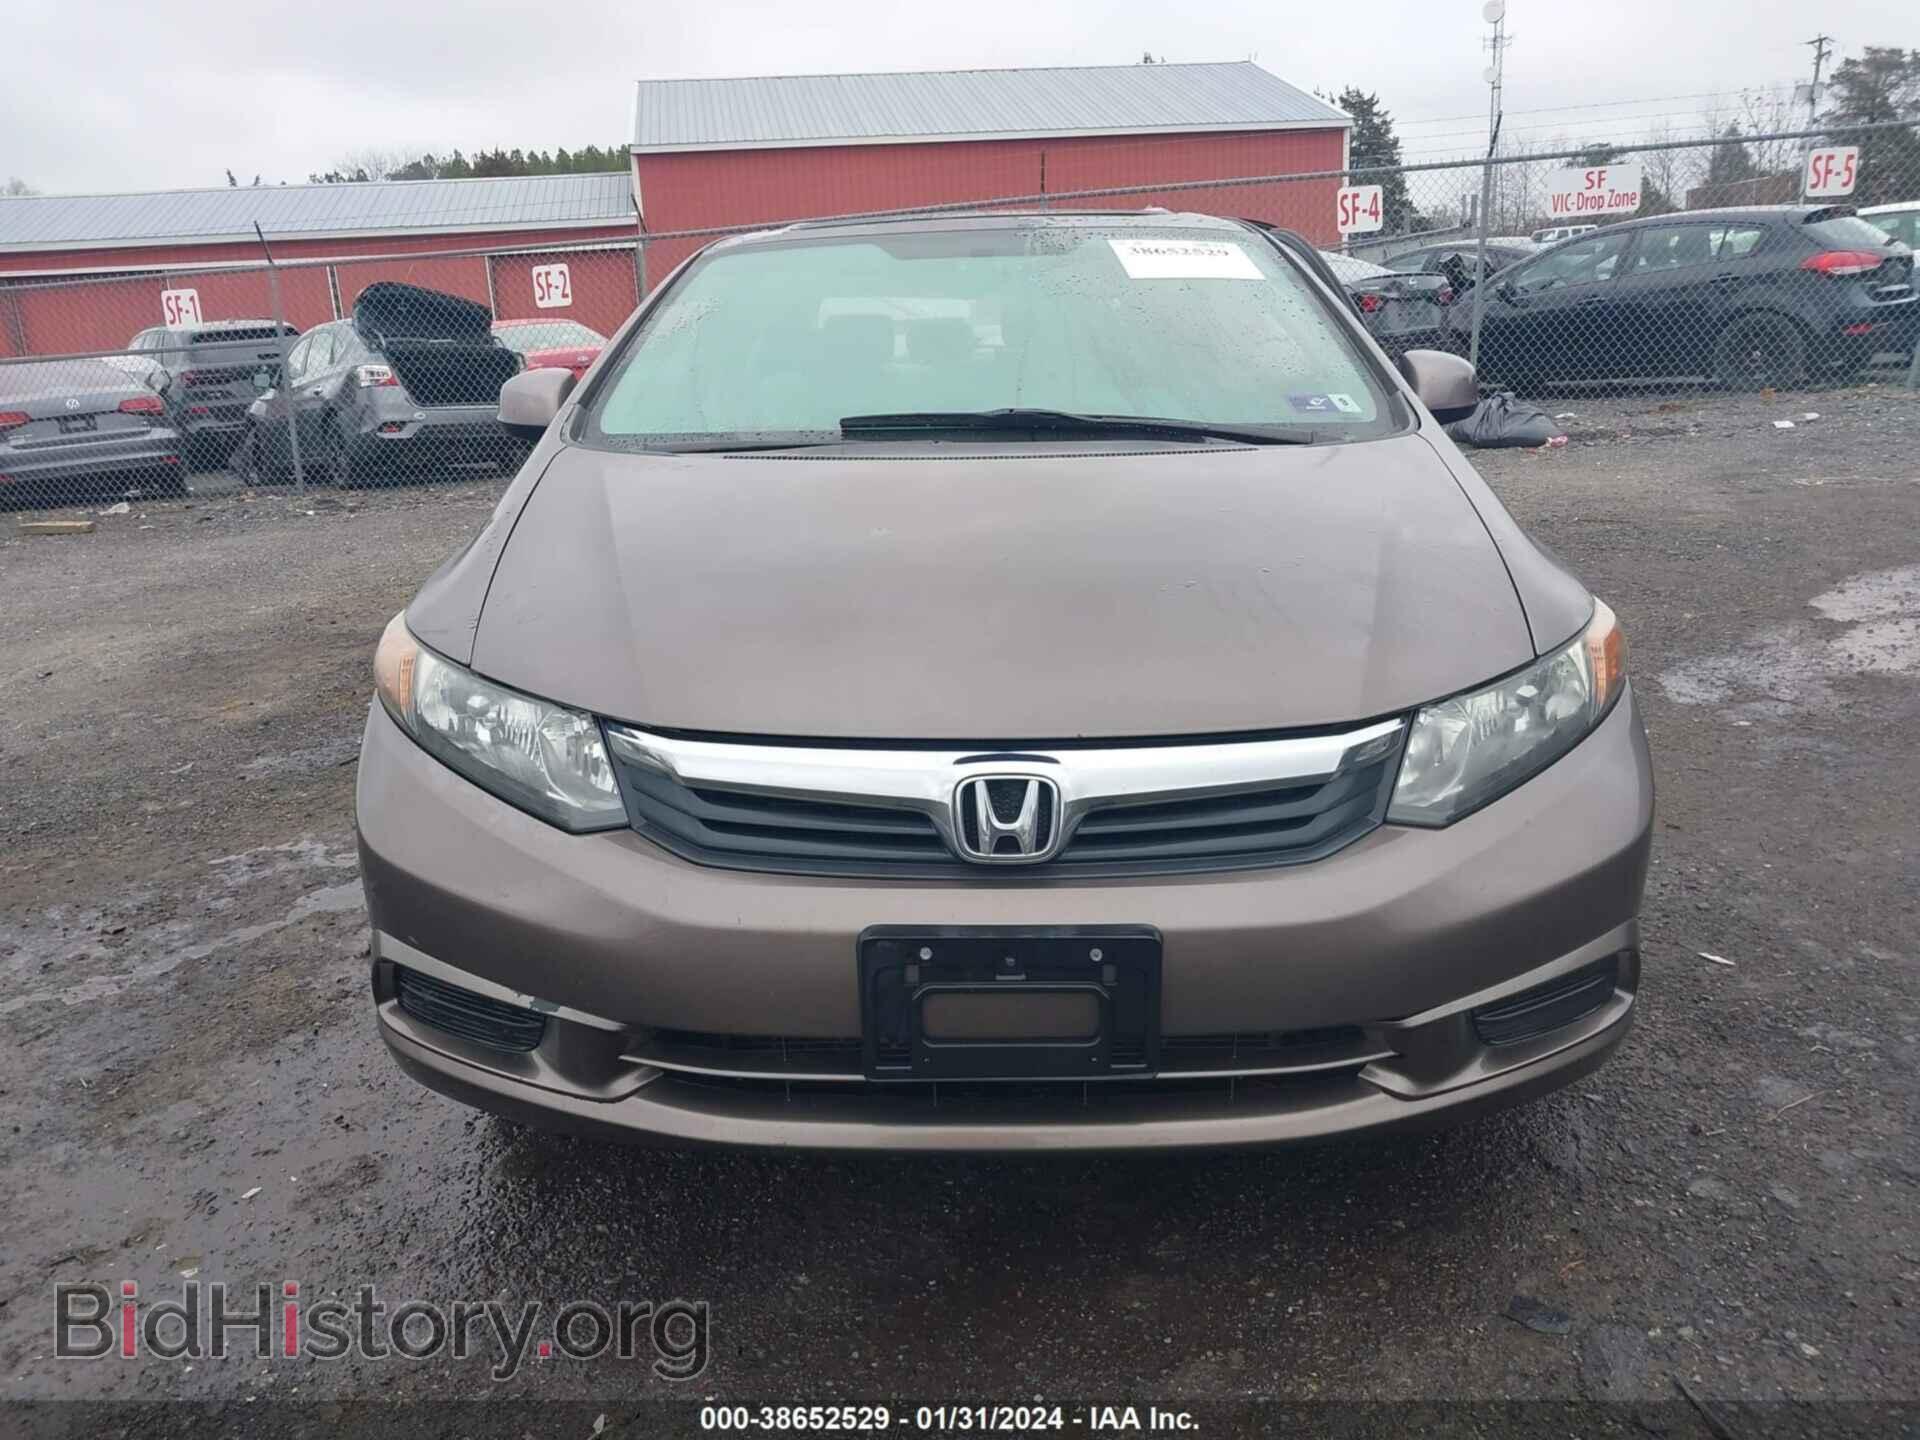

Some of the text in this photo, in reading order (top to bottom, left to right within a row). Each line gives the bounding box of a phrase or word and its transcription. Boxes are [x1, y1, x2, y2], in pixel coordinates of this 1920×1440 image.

[1584, 170, 1607, 190] SF
[1810, 153, 1855, 189] SF-5
[1340, 192, 1380, 226] SF-4
[1551, 188, 1637, 213] VIC-Drop Zone
[536, 270, 569, 301] SF-2
[166, 295, 199, 325] SF-1
